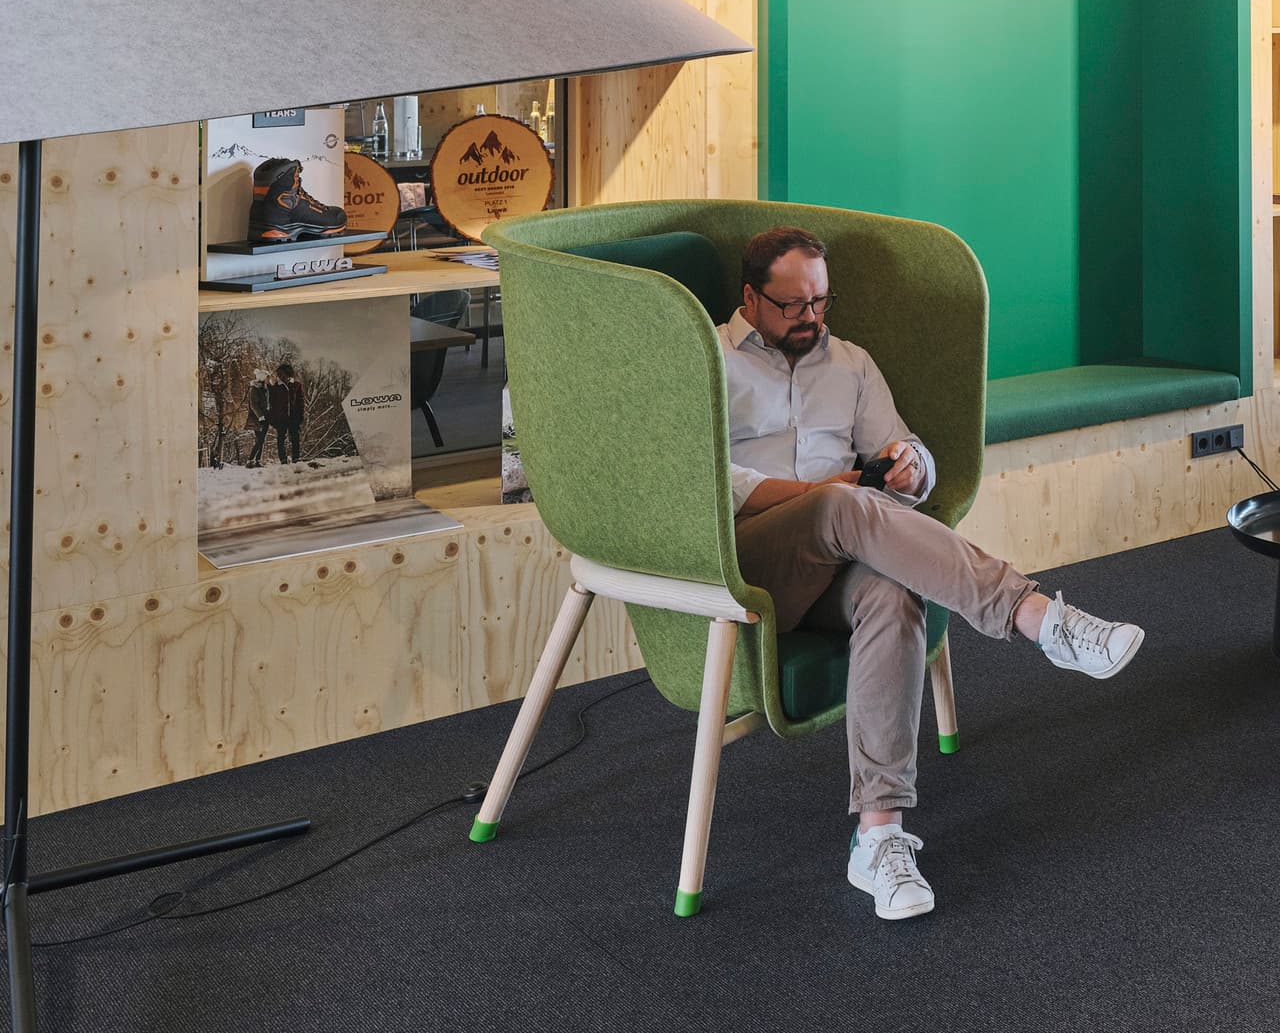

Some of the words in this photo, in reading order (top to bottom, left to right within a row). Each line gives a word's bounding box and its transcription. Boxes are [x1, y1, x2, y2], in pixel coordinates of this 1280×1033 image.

[457, 165, 529, 185] outdoor
[275, 256, 353, 280] LOWA
[350, 393, 402, 407] LOWA
